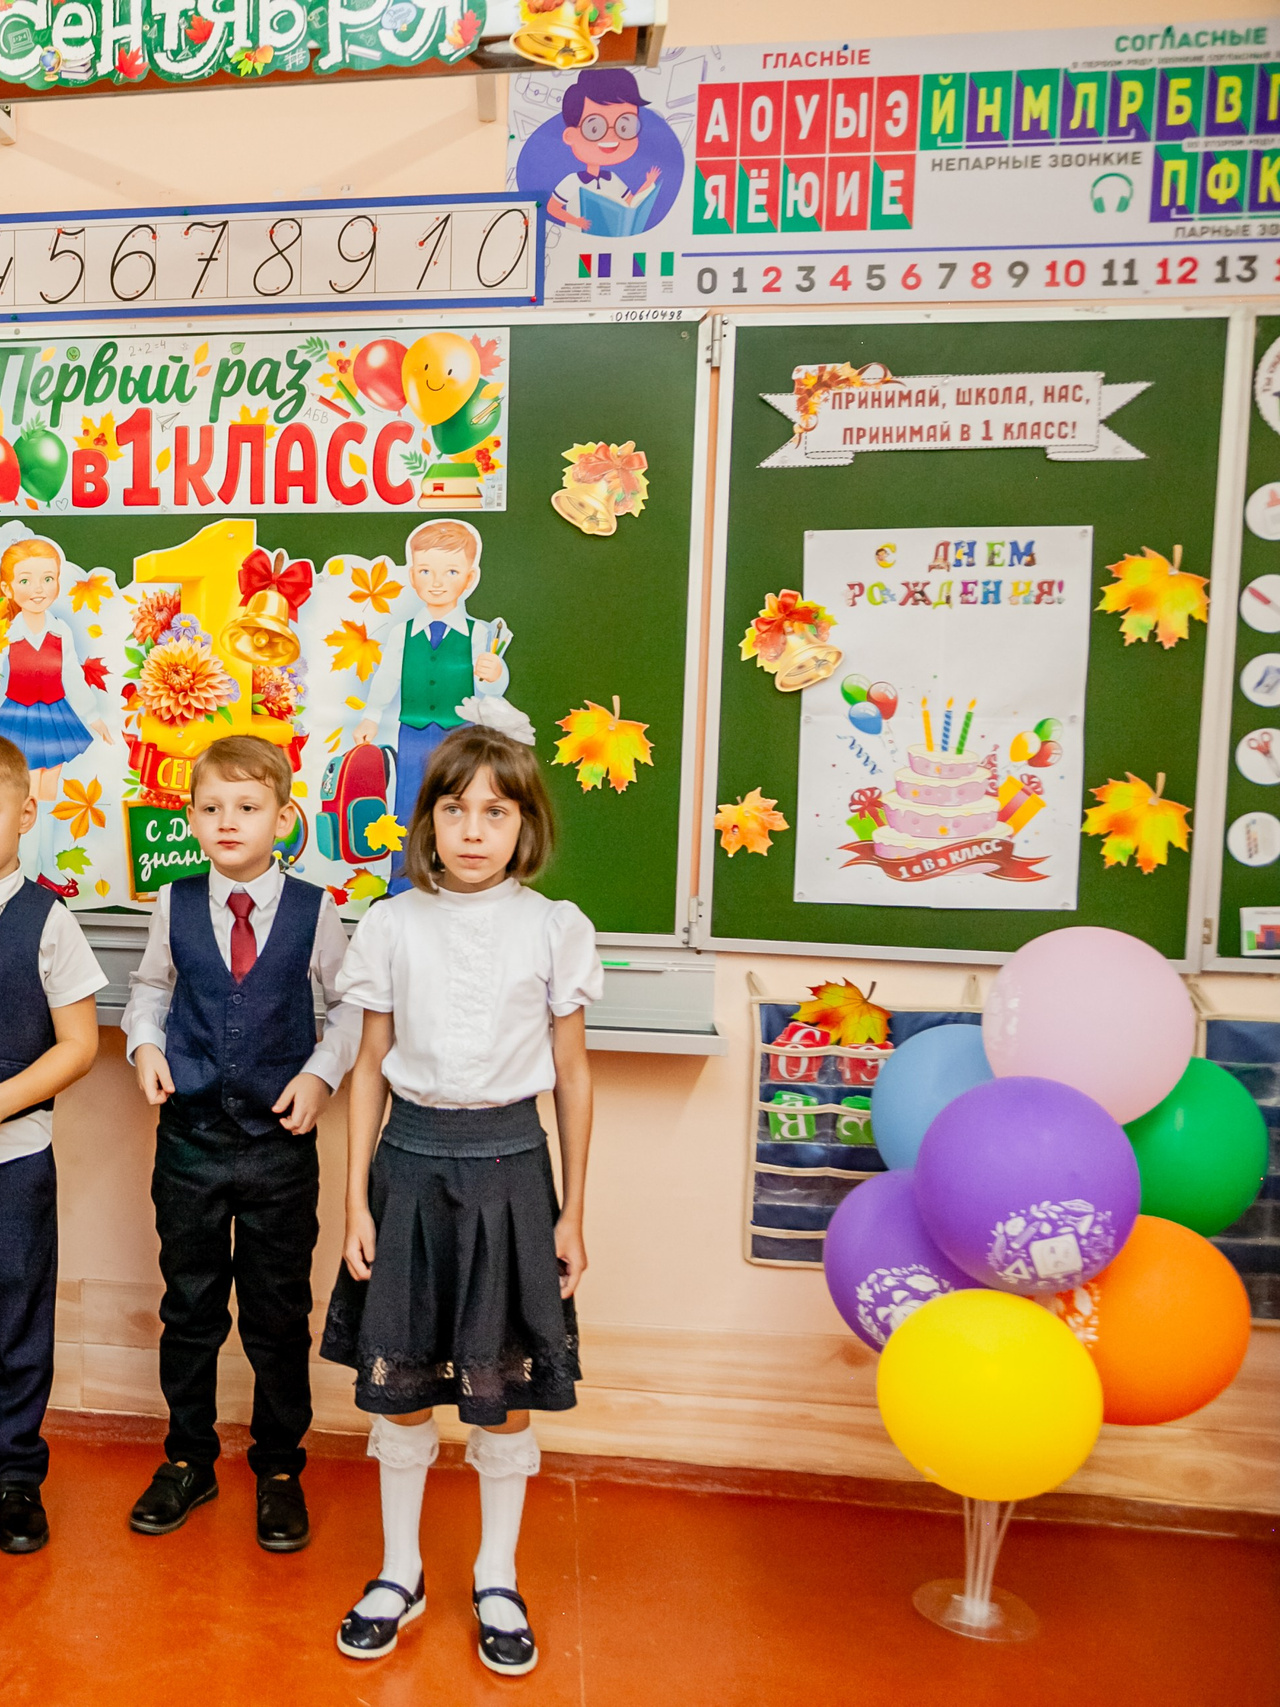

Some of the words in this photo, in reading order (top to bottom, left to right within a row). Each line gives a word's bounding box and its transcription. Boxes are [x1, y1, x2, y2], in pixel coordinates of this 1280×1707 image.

[1115, 26, 1267, 52] СОГЛАСНЫЕ
[761, 48, 871, 70] ГЛАСНЫЕ
[704, 92, 731, 143] А
[750, 98, 774, 142] О
[794, 94, 820, 140] У
[834, 92, 868, 138] Ы
[885, 90, 910, 137] Э
[931, 75, 955, 135] Й
[976, 87, 1003, 133] Н
[1021, 85, 1051, 132] М
[1069, 82, 1097, 130] Л
[1119, 80, 1144, 128] Р
[1166, 77, 1192, 126] Б
[1215, 75, 1242, 124] В
[931, 153, 1042, 172] НЕПАРНЫЕ
[1048, 151, 1142, 169] ЗВОНКИЕ
[703, 173, 727, 220] Я
[747, 165, 770, 223] Ё
[787, 172, 819, 218] Ю
[834, 172, 859, 217] И
[881, 169, 904, 215] Е
[1161, 160, 1188, 206] П
[1206, 158, 1241, 204] Ф
[1174, 223, 1251, 239] ПАРНЫЕ
[39, 227, 85, 304] 5
[110, 225, 156, 301] 6
[184, 220, 229, 299] 7
[253, 218, 302, 296] 8
[329, 215, 377, 293] 9
[697, 267, 717, 294] 0
[732, 267, 747, 293] 1
[762, 266, 782, 292] 2
[795, 265, 816, 292] 3
[829, 265, 852, 291] 4
[866, 264, 886, 291] 5
[901, 264, 922, 290] 6
[938, 263, 957, 289] 7
[971, 262, 992, 289] 8
[1008, 261, 1029, 287] 9
[1045, 260, 1086, 287] 10
[1102, 259, 1138, 286] 11
[1155, 257, 1199, 285] 12
[1215, 255, 1258, 283] 13
[210, 348, 312, 424] раз
[831, 386, 946, 410] ПРИНИМАЙ,
[955, 386, 1033, 406] ШКОЛА,
[1043, 384, 1091, 405] НАС,
[303, 407, 328, 424] АБВ
[842, 421, 951, 445] ПРИНИМАЙ
[981, 420, 993, 441] 1
[1003, 421, 1076, 441] КЛАСС!
[116, 407, 161, 507] 1
[173, 421, 416, 507] КЛАСС
[875, 543, 897, 569] С
[928, 540, 1036, 572] ДНЕМ
[844, 580, 1065, 609] РОЖДЕНИЯ!
[948, 839, 1003, 864] КЛАСС
